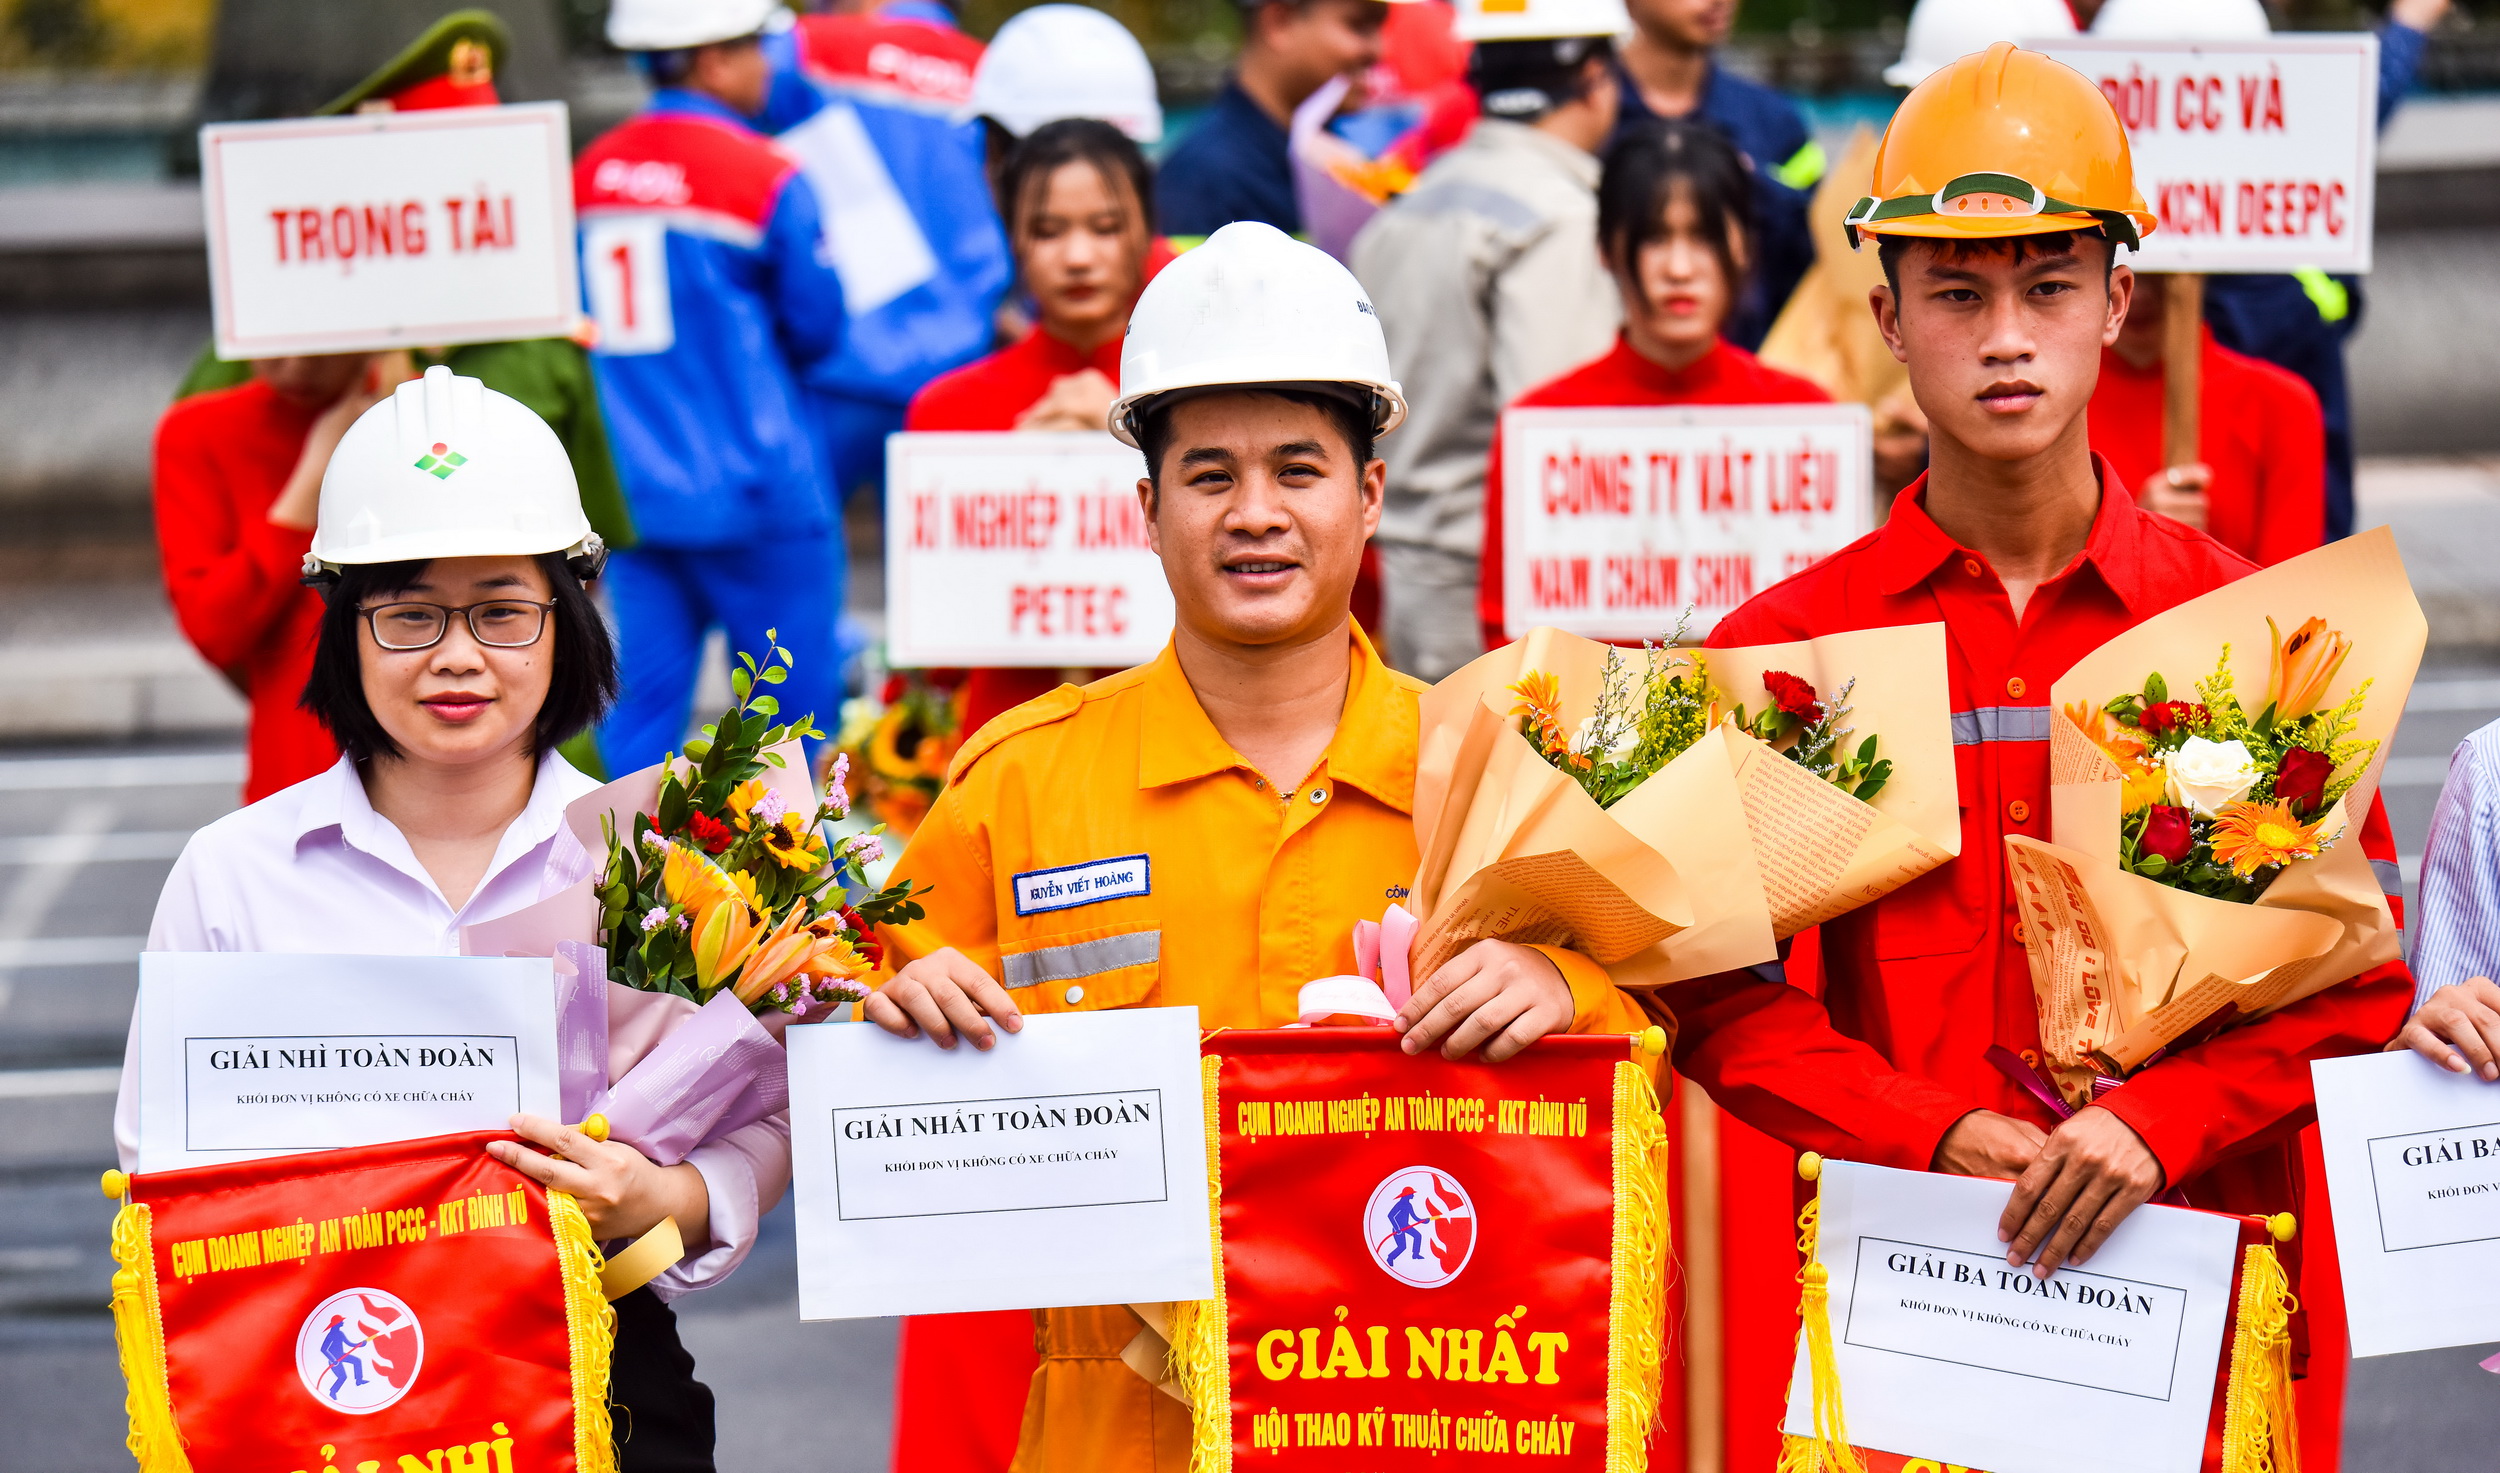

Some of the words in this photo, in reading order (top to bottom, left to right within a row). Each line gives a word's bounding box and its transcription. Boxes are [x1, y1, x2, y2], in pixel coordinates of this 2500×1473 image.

[2175, 76, 2223, 132] CC
[2237, 61, 2286, 131] VÀ
[270, 200, 428, 276] TRỌNG
[445, 181, 517, 253] TÀI
[2157, 182, 2222, 235] KCN
[2237, 182, 2345, 236] DEEPC
[611, 245, 636, 331] 1
[1542, 439, 1632, 516] CÔNG
[1646, 452, 1681, 514] TY
[1529, 556, 1590, 608] NAM
[1009, 584, 1128, 638] PETEC
[1095, 872, 1133, 888] HOÀNG
[1385, 884, 1410, 898] CÔN
[1496, 906, 1521, 930] THE
[2076, 919, 2096, 949] DO
[2081, 971, 2101, 1029] LOVE
[211, 1045, 270, 1069] GIẢI
[279, 1044, 327, 1068] NHÌ
[336, 1043, 410, 1067] TOÀN
[418, 1043, 493, 1067] ĐOÀN
[271, 1093, 299, 1103] ĐƠN
[301, 1094, 314, 1105] VỊ
[317, 1091, 360, 1103] KHÔNG
[364, 1091, 382, 1102] CÓ
[385, 1093, 400, 1102] XE
[403, 1091, 438, 1102] CHỮA
[441, 1091, 474, 1101] CHÁY
[845, 1113, 904, 1140] GIẢI
[912, 1109, 985, 1136] NHẤT
[993, 1104, 1066, 1131] TOÀN
[1074, 1099, 1150, 1126] ĐOÀN
[1238, 1102, 1271, 1143] CỤM
[1274, 1101, 1324, 1136] DOANH
[1328, 1092, 1380, 1139] NGHIỆP
[1385, 1097, 1404, 1131] AN
[1407, 1090, 1443, 1131] TOÀN
[1446, 1098, 1484, 1132] PCCC
[1497, 1100, 1526, 1134] KKT
[1529, 1094, 1564, 1136] ĐÌNH
[1568, 1097, 1587, 1137] VŨ
[918, 1159, 944, 1171] ĐƠN
[947, 1160, 960, 1171] VỊ
[963, 1155, 1006, 1168] KHÔNG
[1009, 1153, 1026, 1165] CÓ
[1029, 1154, 1044, 1164] XE
[1047, 1150, 1082, 1163] CHỮA
[1085, 1149, 1118, 1162] CHÁY
[2403, 1137, 2463, 1166] GIẢI
[171, 1239, 208, 1283] CỤM
[208, 1231, 262, 1273] DOANH
[262, 1217, 316, 1264] NGHIỆP
[319, 1218, 341, 1254] AN
[343, 1207, 383, 1250] TOÀN
[386, 1207, 426, 1245] PCCC
[439, 1198, 465, 1236] KKT
[468, 1189, 505, 1230] ĐÌNH
[1887, 1253, 1946, 1280] GIẢI
[1954, 1263, 1987, 1287] BA
[2078, 1287, 2153, 1316] ĐOÀN
[1257, 1305, 1390, 1380] GIẢI
[1404, 1305, 1569, 1384] NHẤT
[1962, 1310, 1974, 1322] VỊ
[1977, 1312, 2020, 1328] KHÔNG
[2023, 1319, 2040, 1331] CÓ
[2042, 1323, 2058, 1335] XE
[2061, 1326, 2095, 1341] CHỮA
[2098, 1334, 2132, 1347] CHÁY
[1253, 1407, 1288, 1455] HỘI
[1294, 1413, 1350, 1446] THAO
[1358, 1406, 1386, 1447] KỸ
[1391, 1408, 1451, 1456] THUẬT
[1455, 1410, 1509, 1453] CHỮA
[1516, 1414, 1575, 1455] CHÁY
